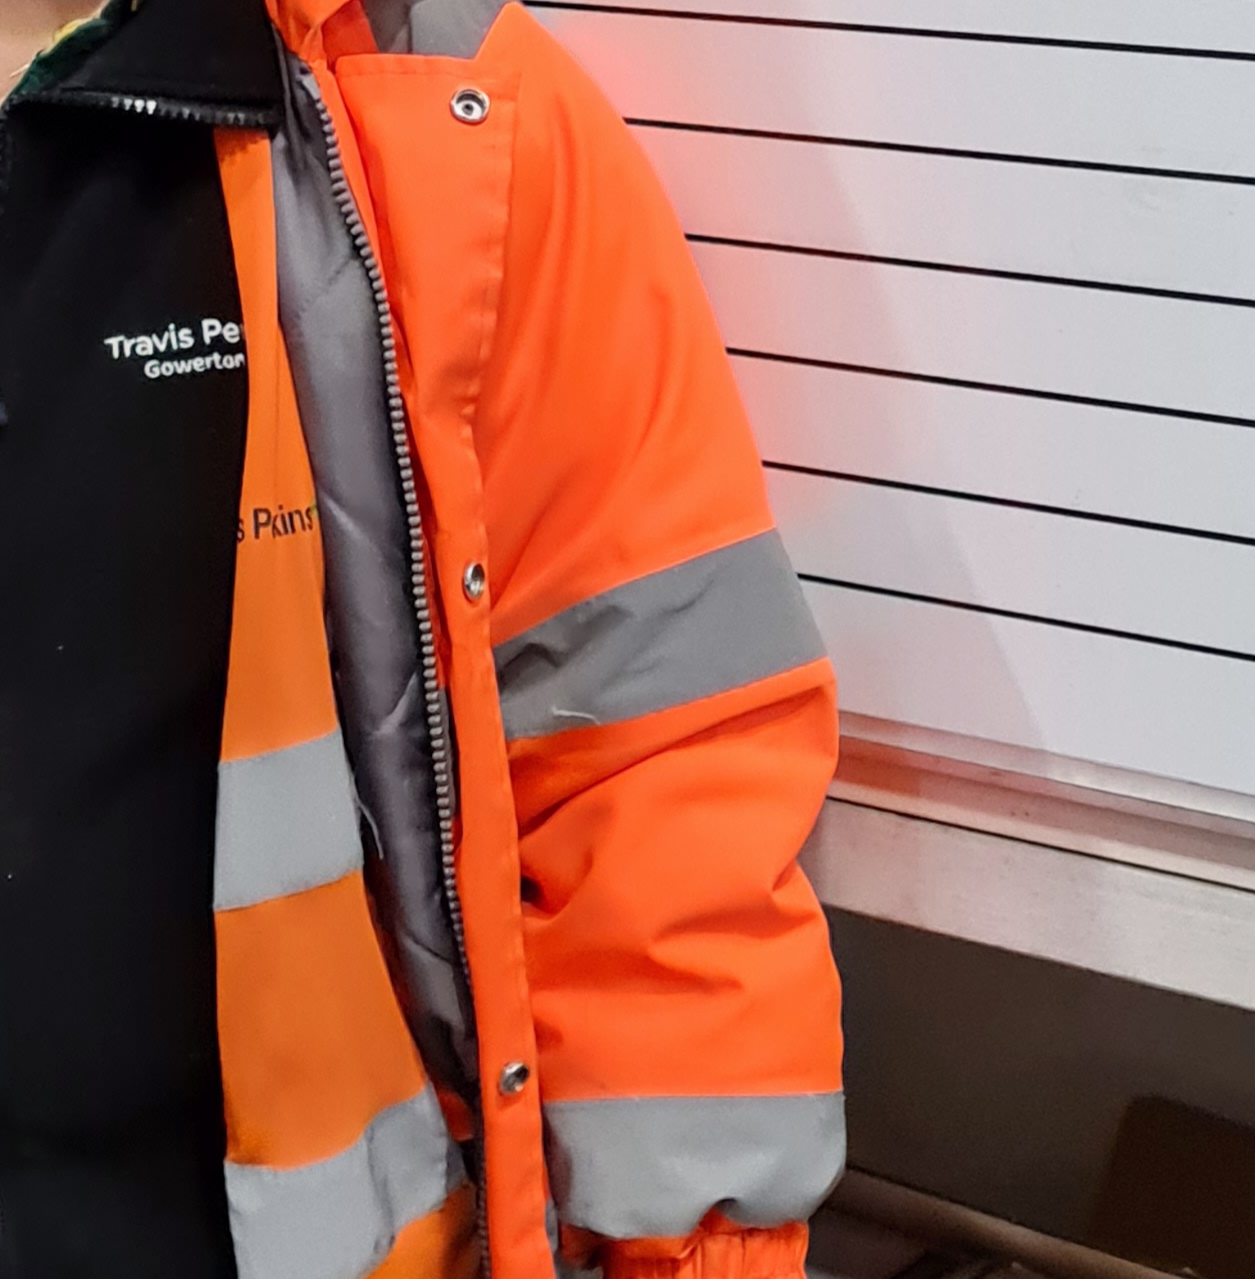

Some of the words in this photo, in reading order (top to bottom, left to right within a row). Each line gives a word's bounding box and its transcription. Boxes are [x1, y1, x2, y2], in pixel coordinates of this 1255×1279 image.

[104, 323, 194, 359] Travis
[201, 318, 244, 345] Pe
[144, 351, 245, 379] Gowerton
